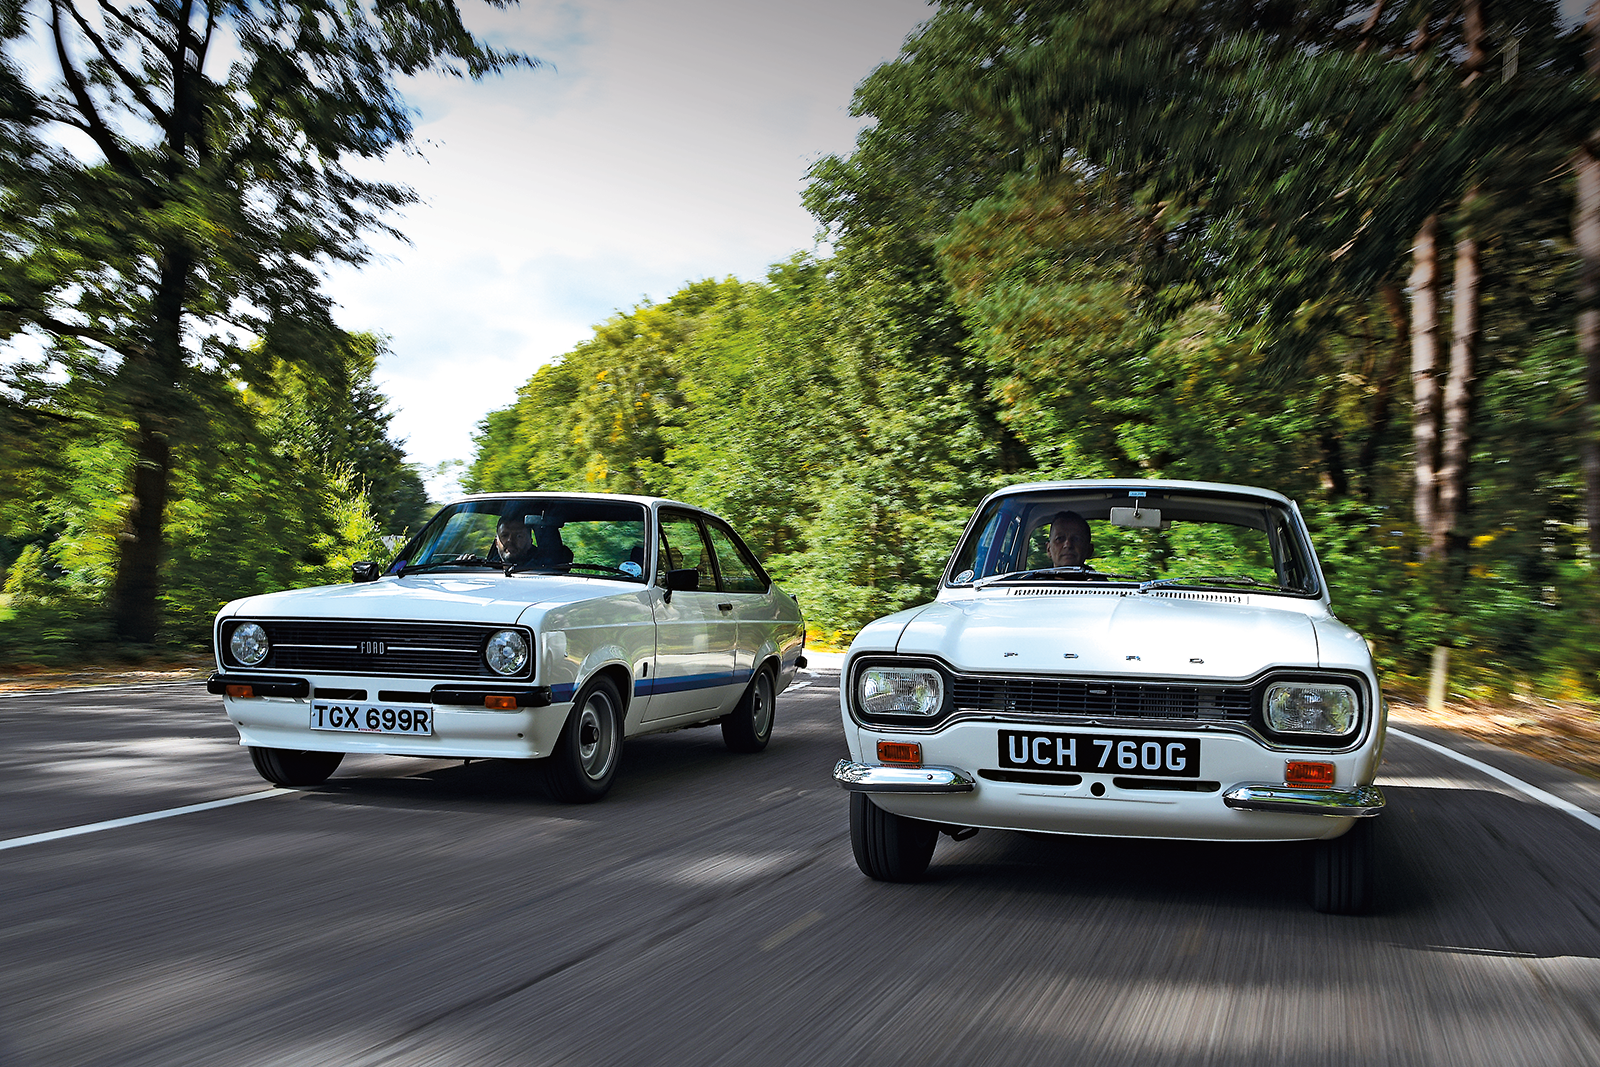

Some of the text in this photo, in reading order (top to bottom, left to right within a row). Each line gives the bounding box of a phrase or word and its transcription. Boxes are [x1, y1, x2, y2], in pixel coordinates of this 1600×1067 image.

[361, 641, 384, 655] FORD
[1003, 652, 1205, 664] FORD
[314, 705, 429, 732] TGX 699R
[1008, 735, 1187, 772] UCH 760G
